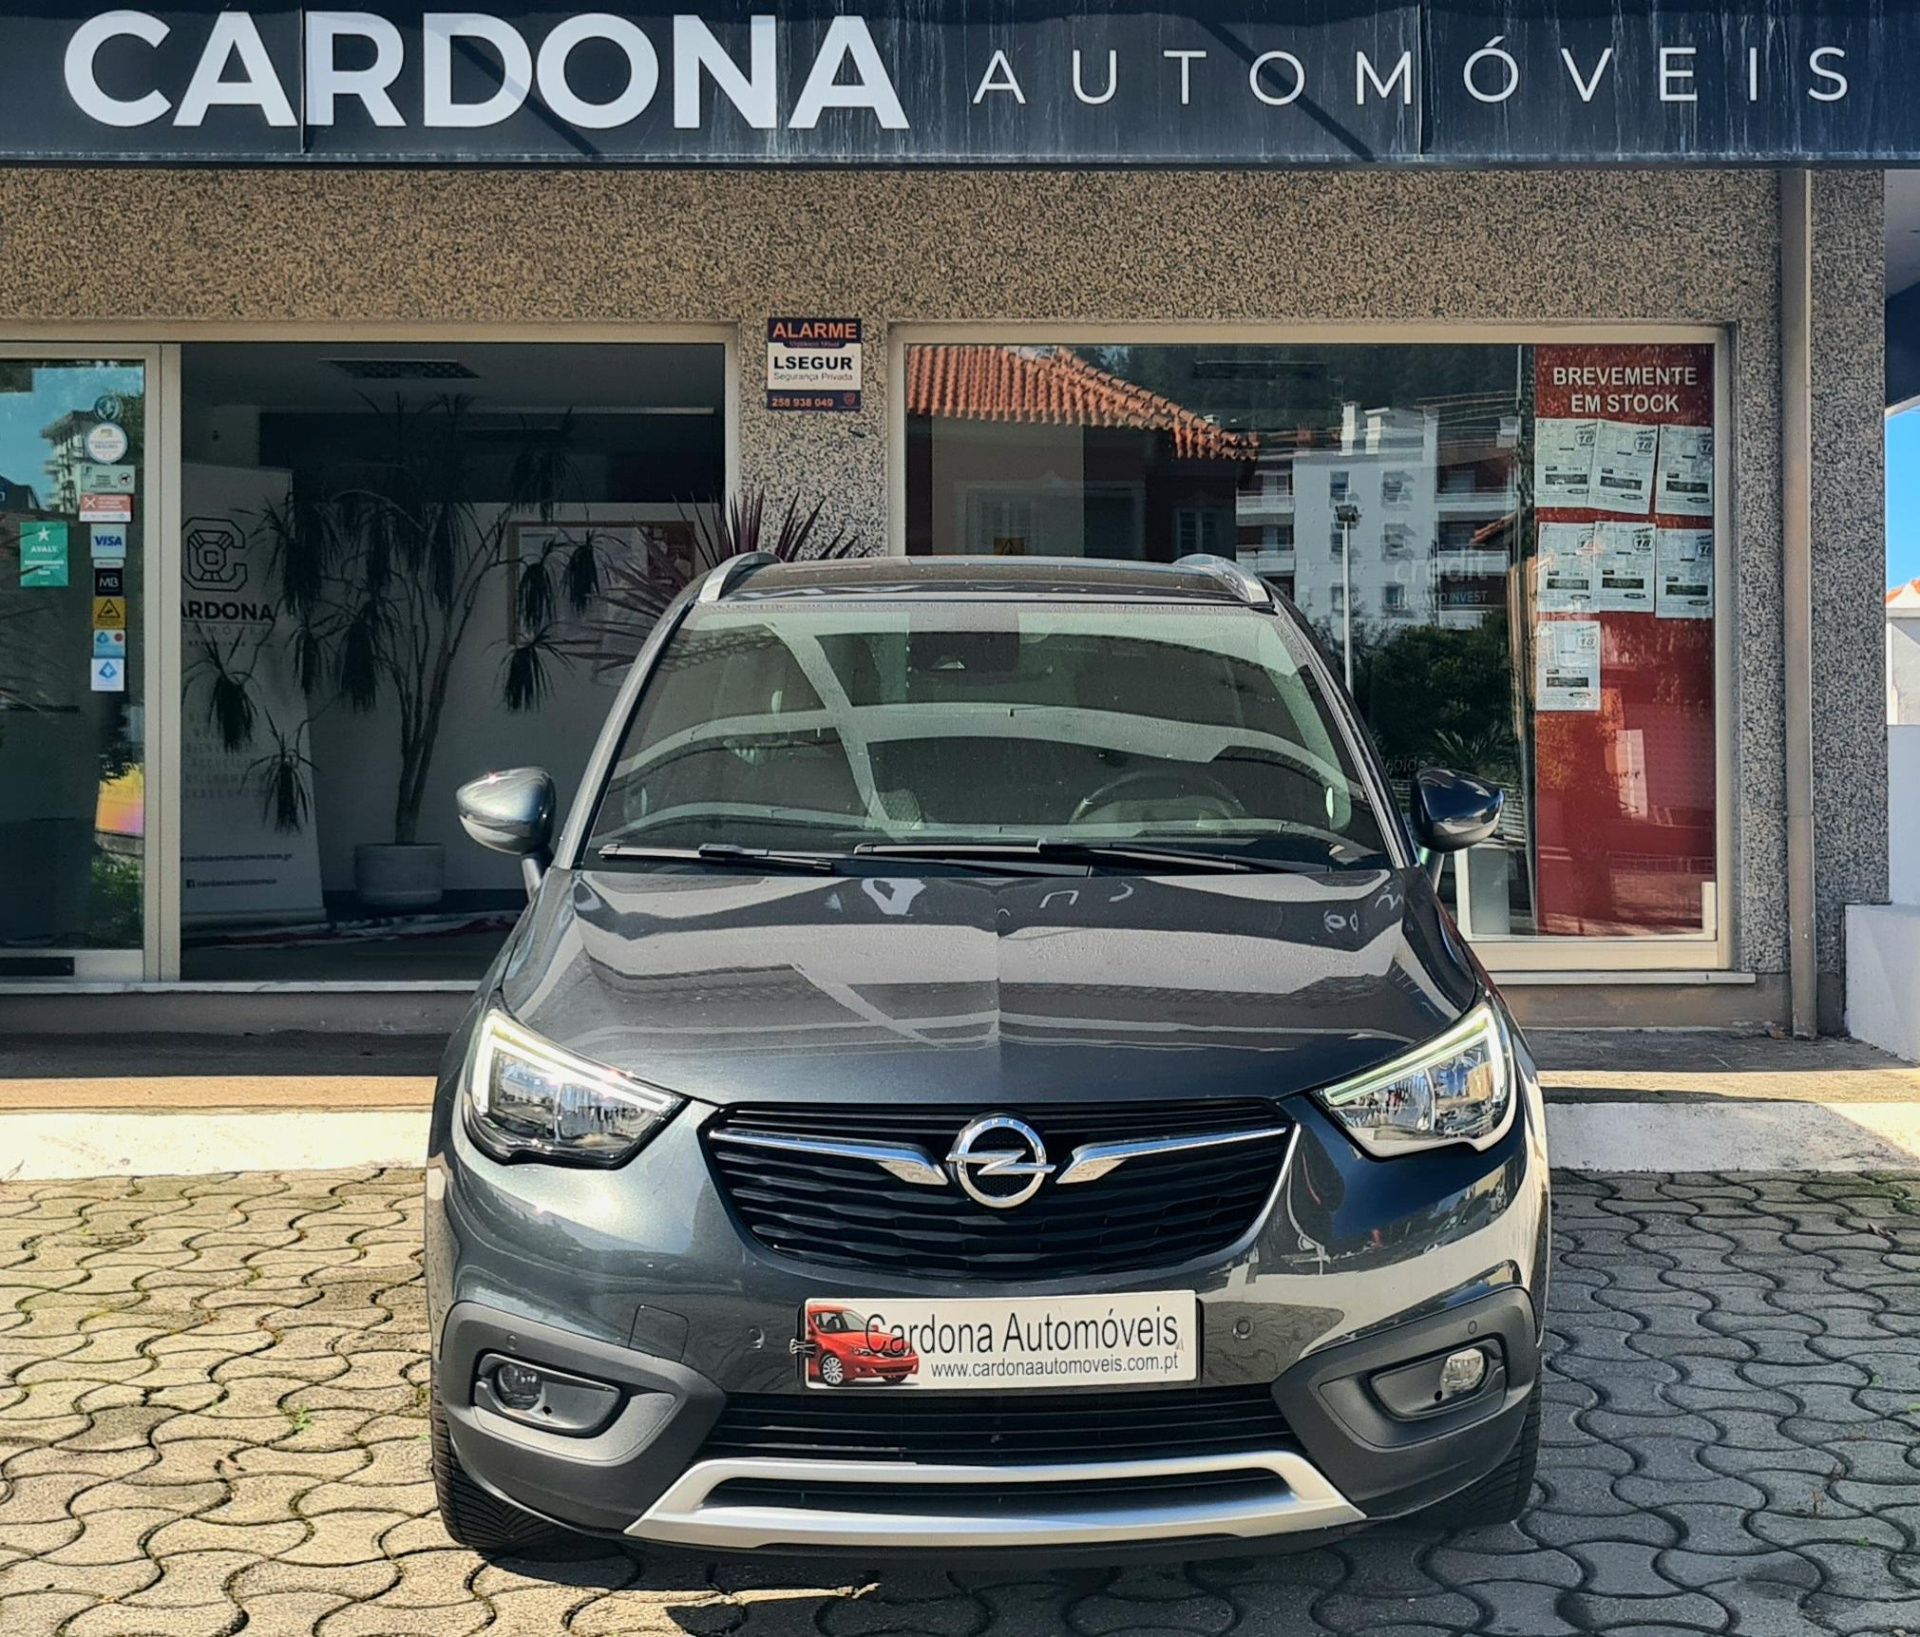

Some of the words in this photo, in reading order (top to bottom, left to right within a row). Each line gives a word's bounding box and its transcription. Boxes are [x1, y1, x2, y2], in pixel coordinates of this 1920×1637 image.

[64, 10, 909, 130] CARDONA
[972, 35, 1849, 106] AUTOMÓVEIS
[773, 322, 857, 338] ALARME
[774, 356, 852, 370] LSEGUR
[1553, 366, 1698, 386] BREVEMENTE
[793, 397, 812, 408] 938
[1570, 394, 1600, 413] EM
[1607, 394, 1680, 413] STOCK
[94, 535, 123, 546] VISA
[1449, 590, 1488, 602] INVEST
[181, 600, 275, 621] RDONA
[865, 1313, 993, 1354] Cardona
[1002, 1305, 1179, 1353] Automóveis
[930, 1352, 1179, 1378] www.cardonaautomoveis.com.pt
